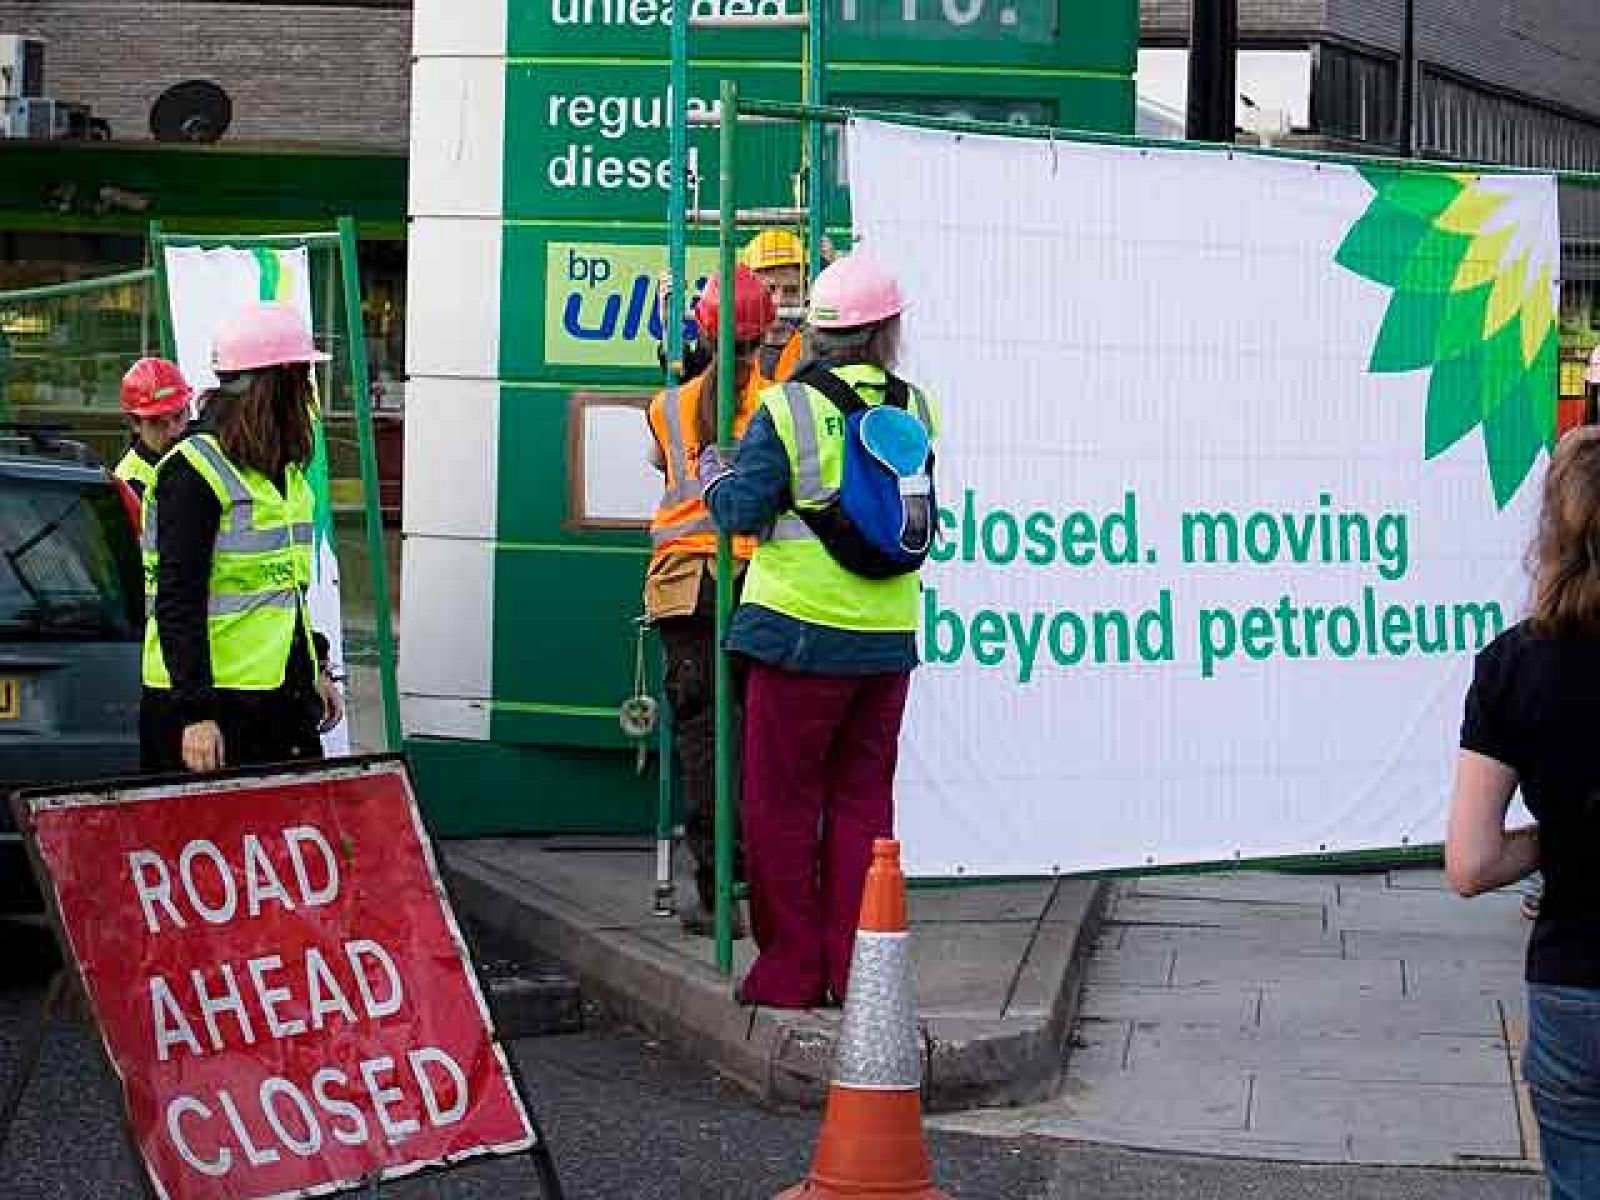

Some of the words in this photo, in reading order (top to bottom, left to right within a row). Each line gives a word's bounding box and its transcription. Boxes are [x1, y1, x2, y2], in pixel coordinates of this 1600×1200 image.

[570, 249, 610, 288] bp
[928, 489, 1156, 566] closed.
[1182, 493, 1408, 580] moving
[924, 588, 1174, 682] beyond
[1200, 587, 1504, 677] petroleum
[128, 825, 339, 932] ROAD
[148, 939, 403, 1061] AHEAD
[166, 1047, 468, 1176] CLOSED
